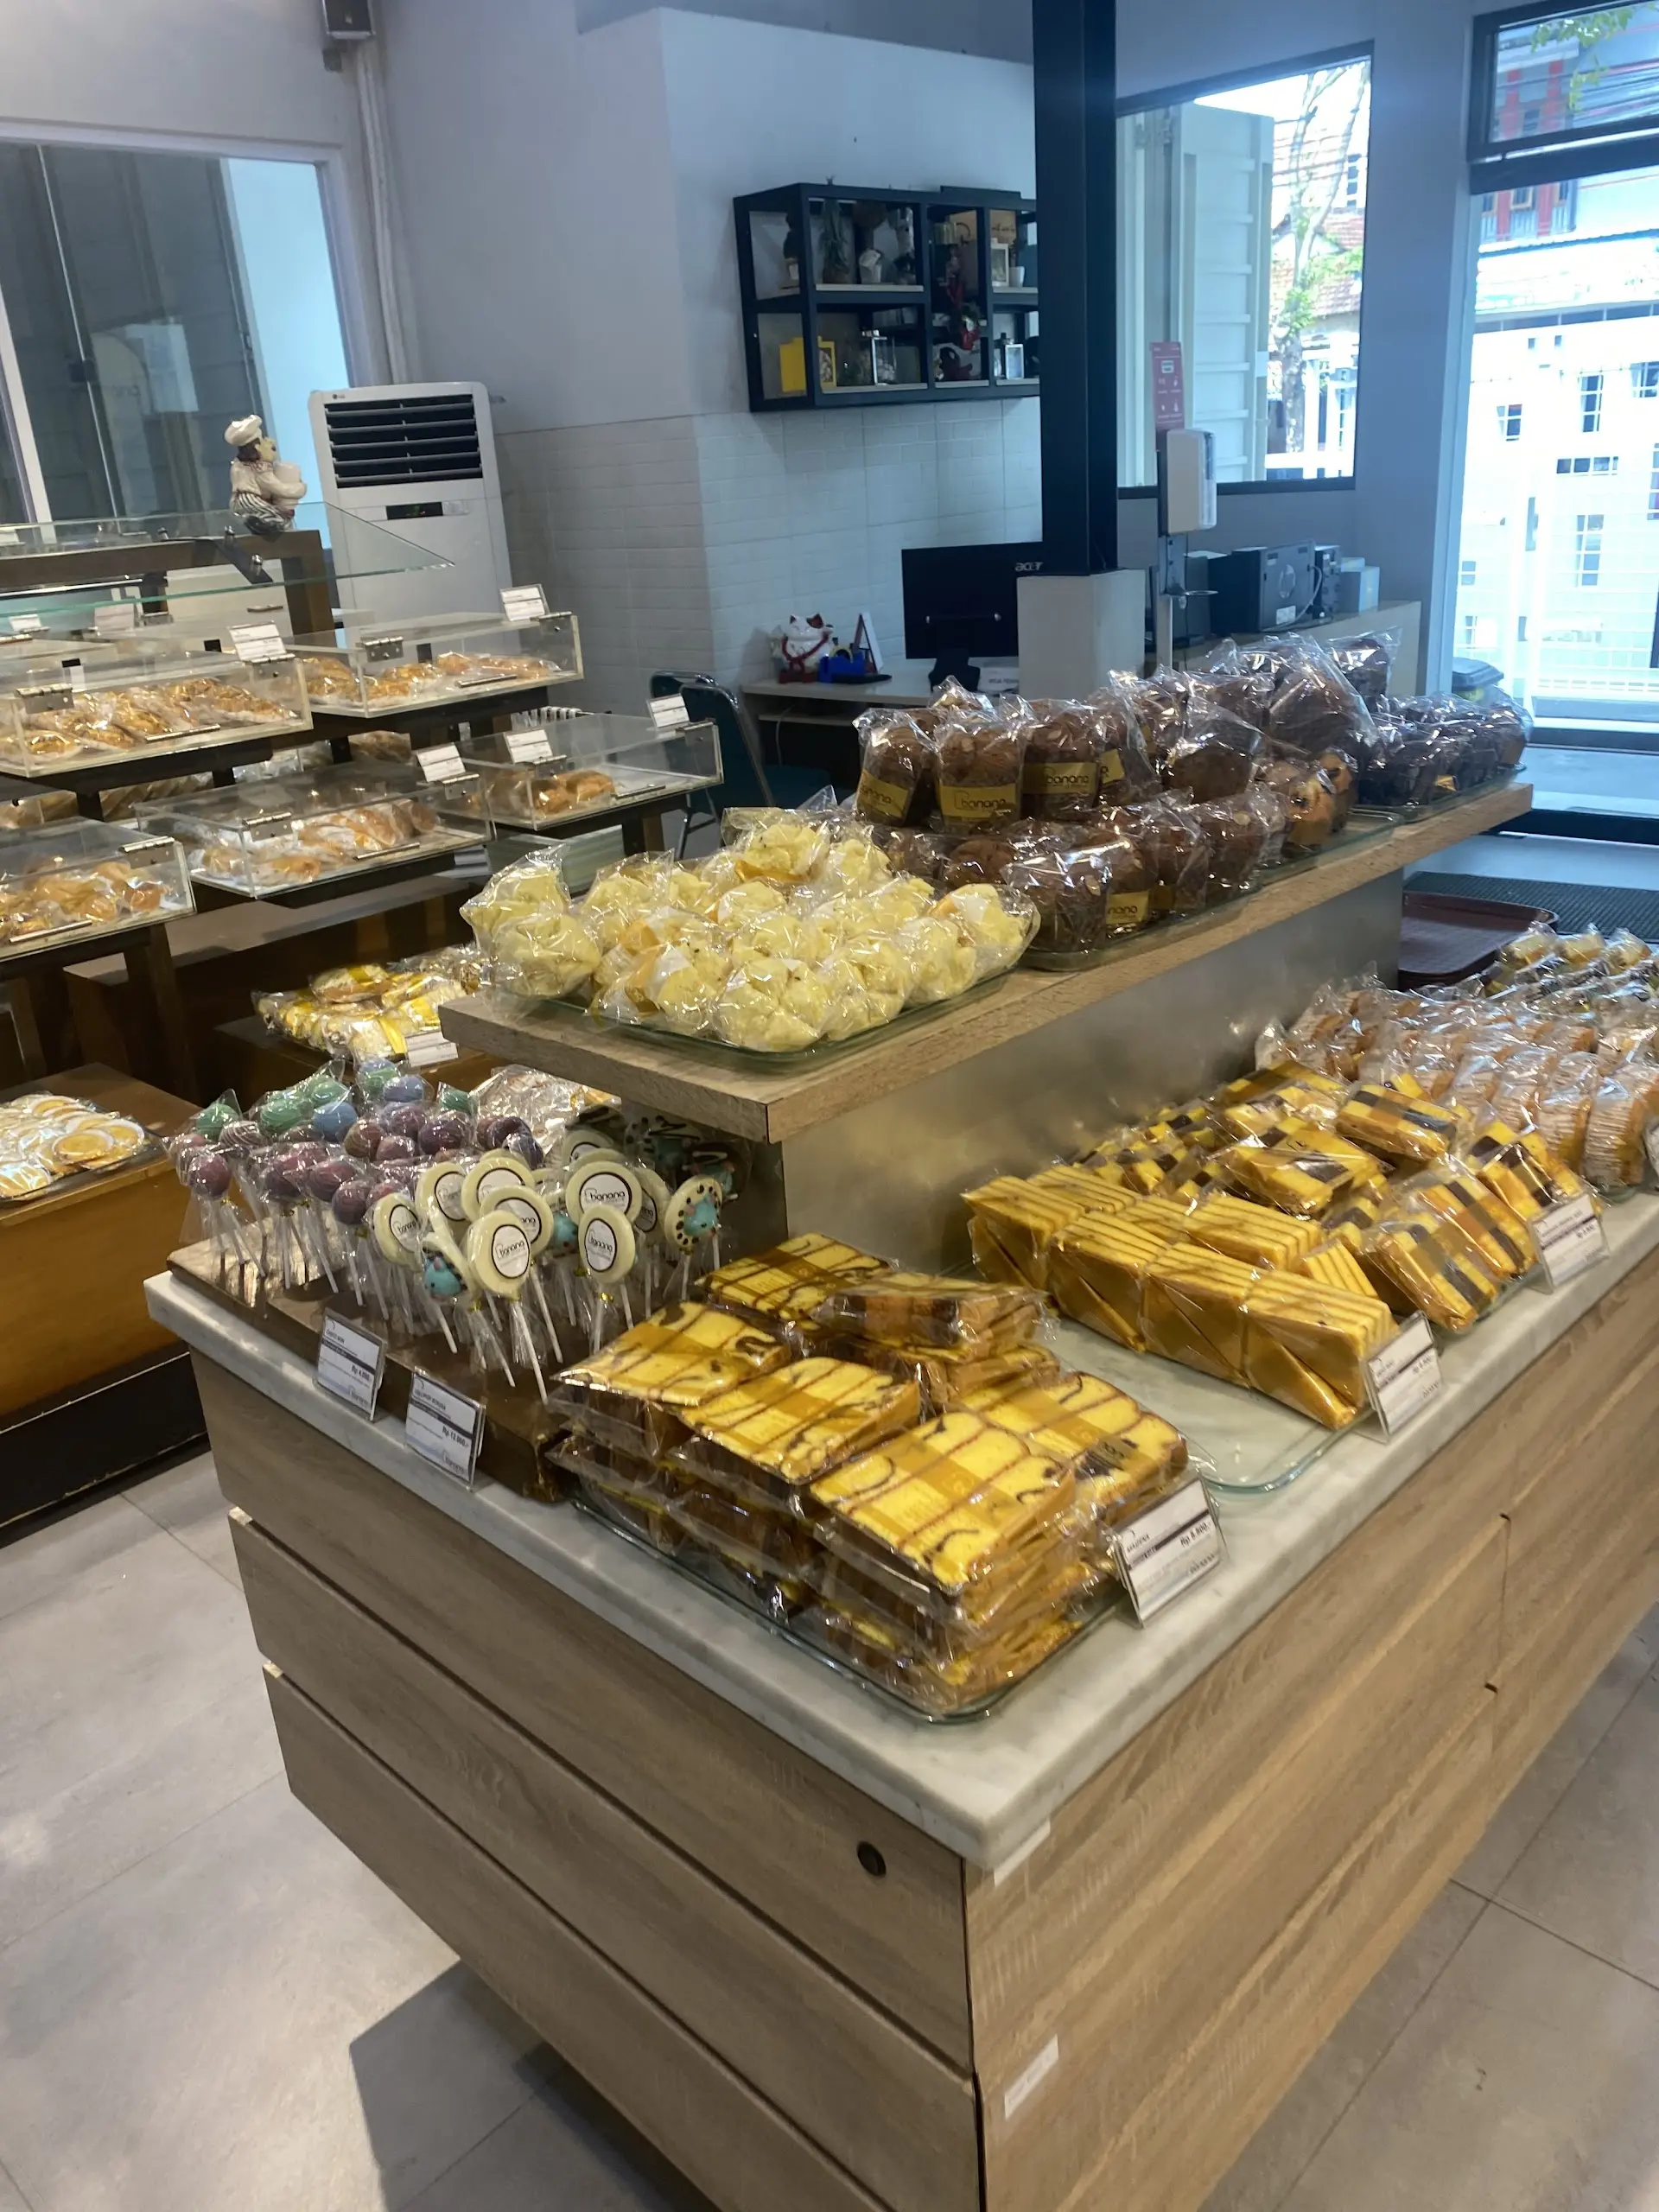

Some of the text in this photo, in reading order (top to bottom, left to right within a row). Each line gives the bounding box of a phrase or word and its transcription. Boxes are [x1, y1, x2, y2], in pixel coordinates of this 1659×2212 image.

[1014, 562, 1043, 571] acer
[961, 797, 1007, 810] banana
[1108, 905, 1138, 914] nana
[590, 1191, 626, 1202] banana
[499, 1240, 524, 1256] banana
[591, 1236, 613, 1253] banana
